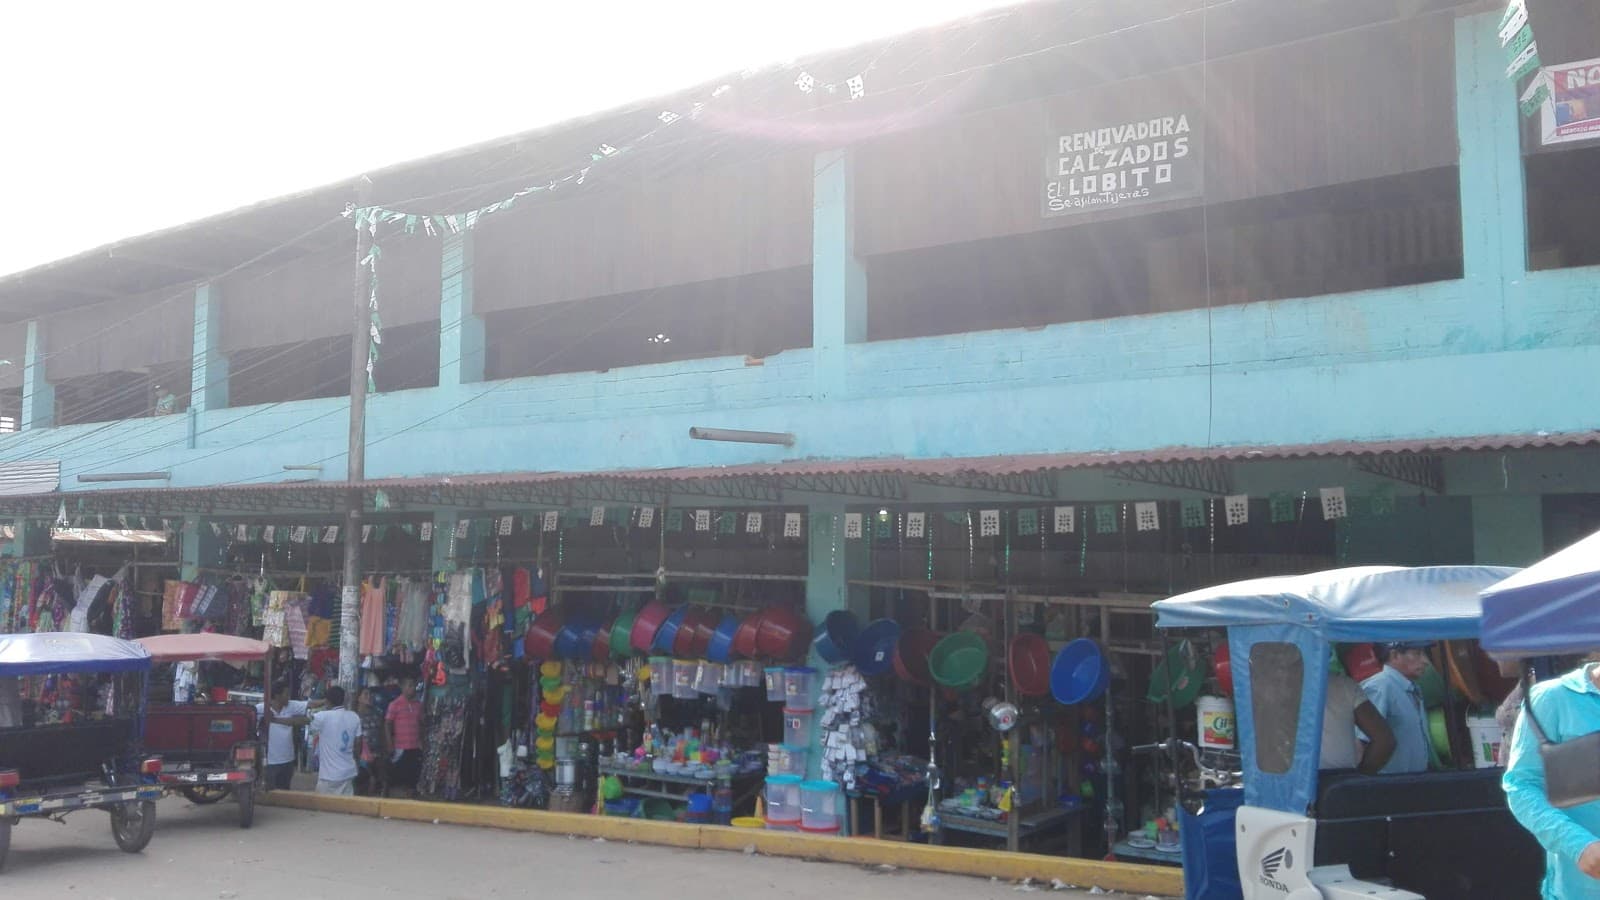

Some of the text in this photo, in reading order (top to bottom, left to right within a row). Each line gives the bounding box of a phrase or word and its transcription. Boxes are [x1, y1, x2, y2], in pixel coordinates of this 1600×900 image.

[1059, 114, 1190, 153] RENOVADORA
[1058, 137, 1189, 176] CALZADOS
[1069, 163, 1172, 196] LOBITO
